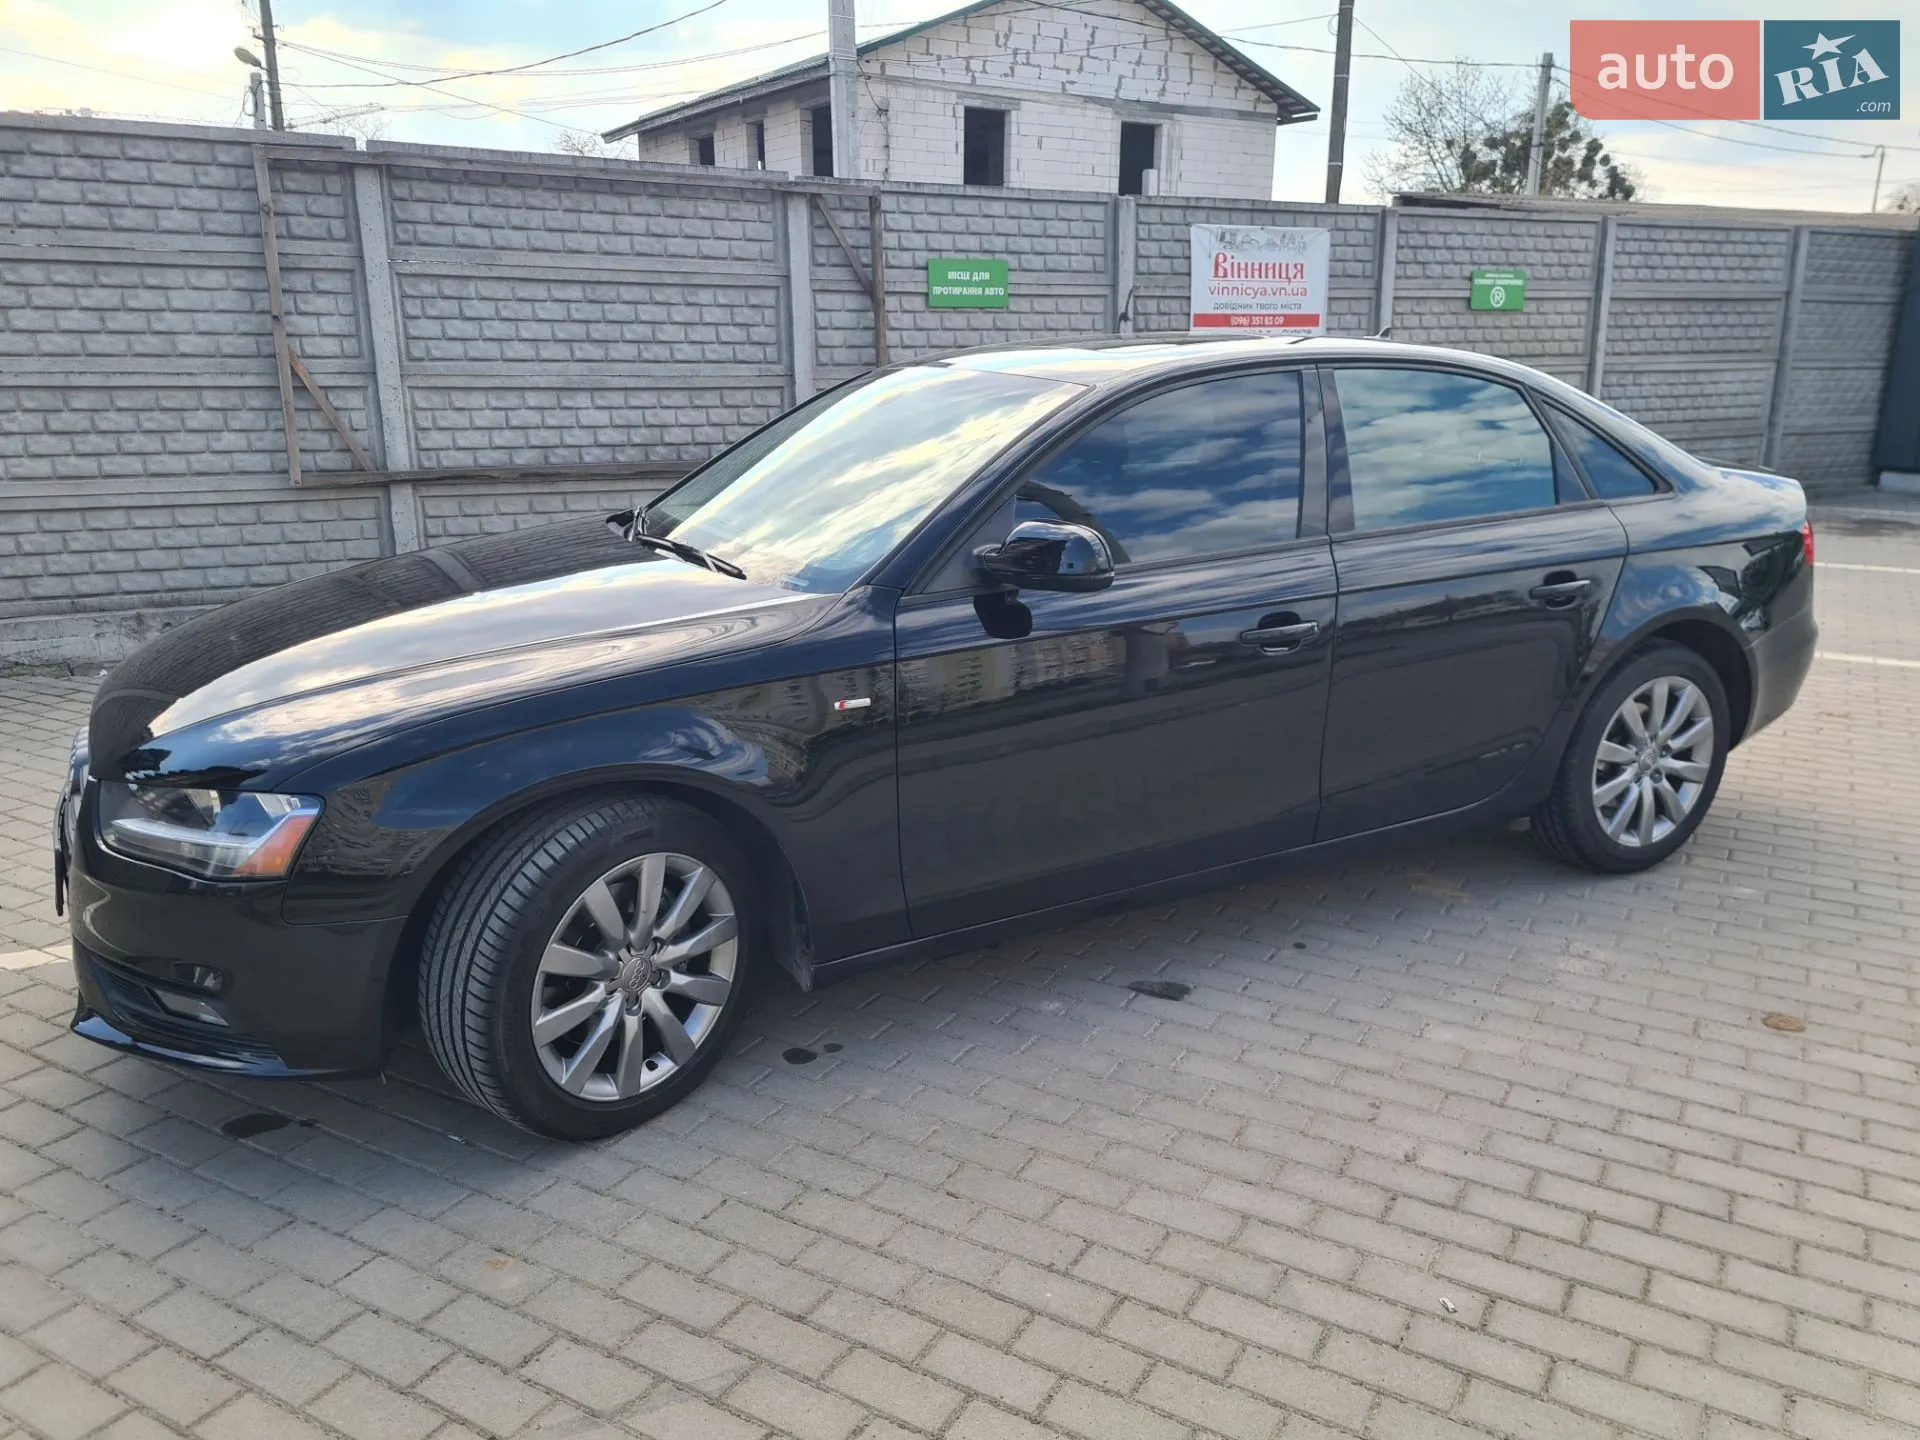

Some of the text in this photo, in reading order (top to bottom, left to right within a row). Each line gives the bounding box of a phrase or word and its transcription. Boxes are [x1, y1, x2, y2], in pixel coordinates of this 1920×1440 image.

[1212, 252, 1304, 284] Вінниця
[948, 271, 990, 281] МІСЦЕ ДЛЯ
[932, 286, 1004, 295] ПРОТИРАННЯ АВТО
[1208, 283, 1308, 299] vinnicya.vn.ua
